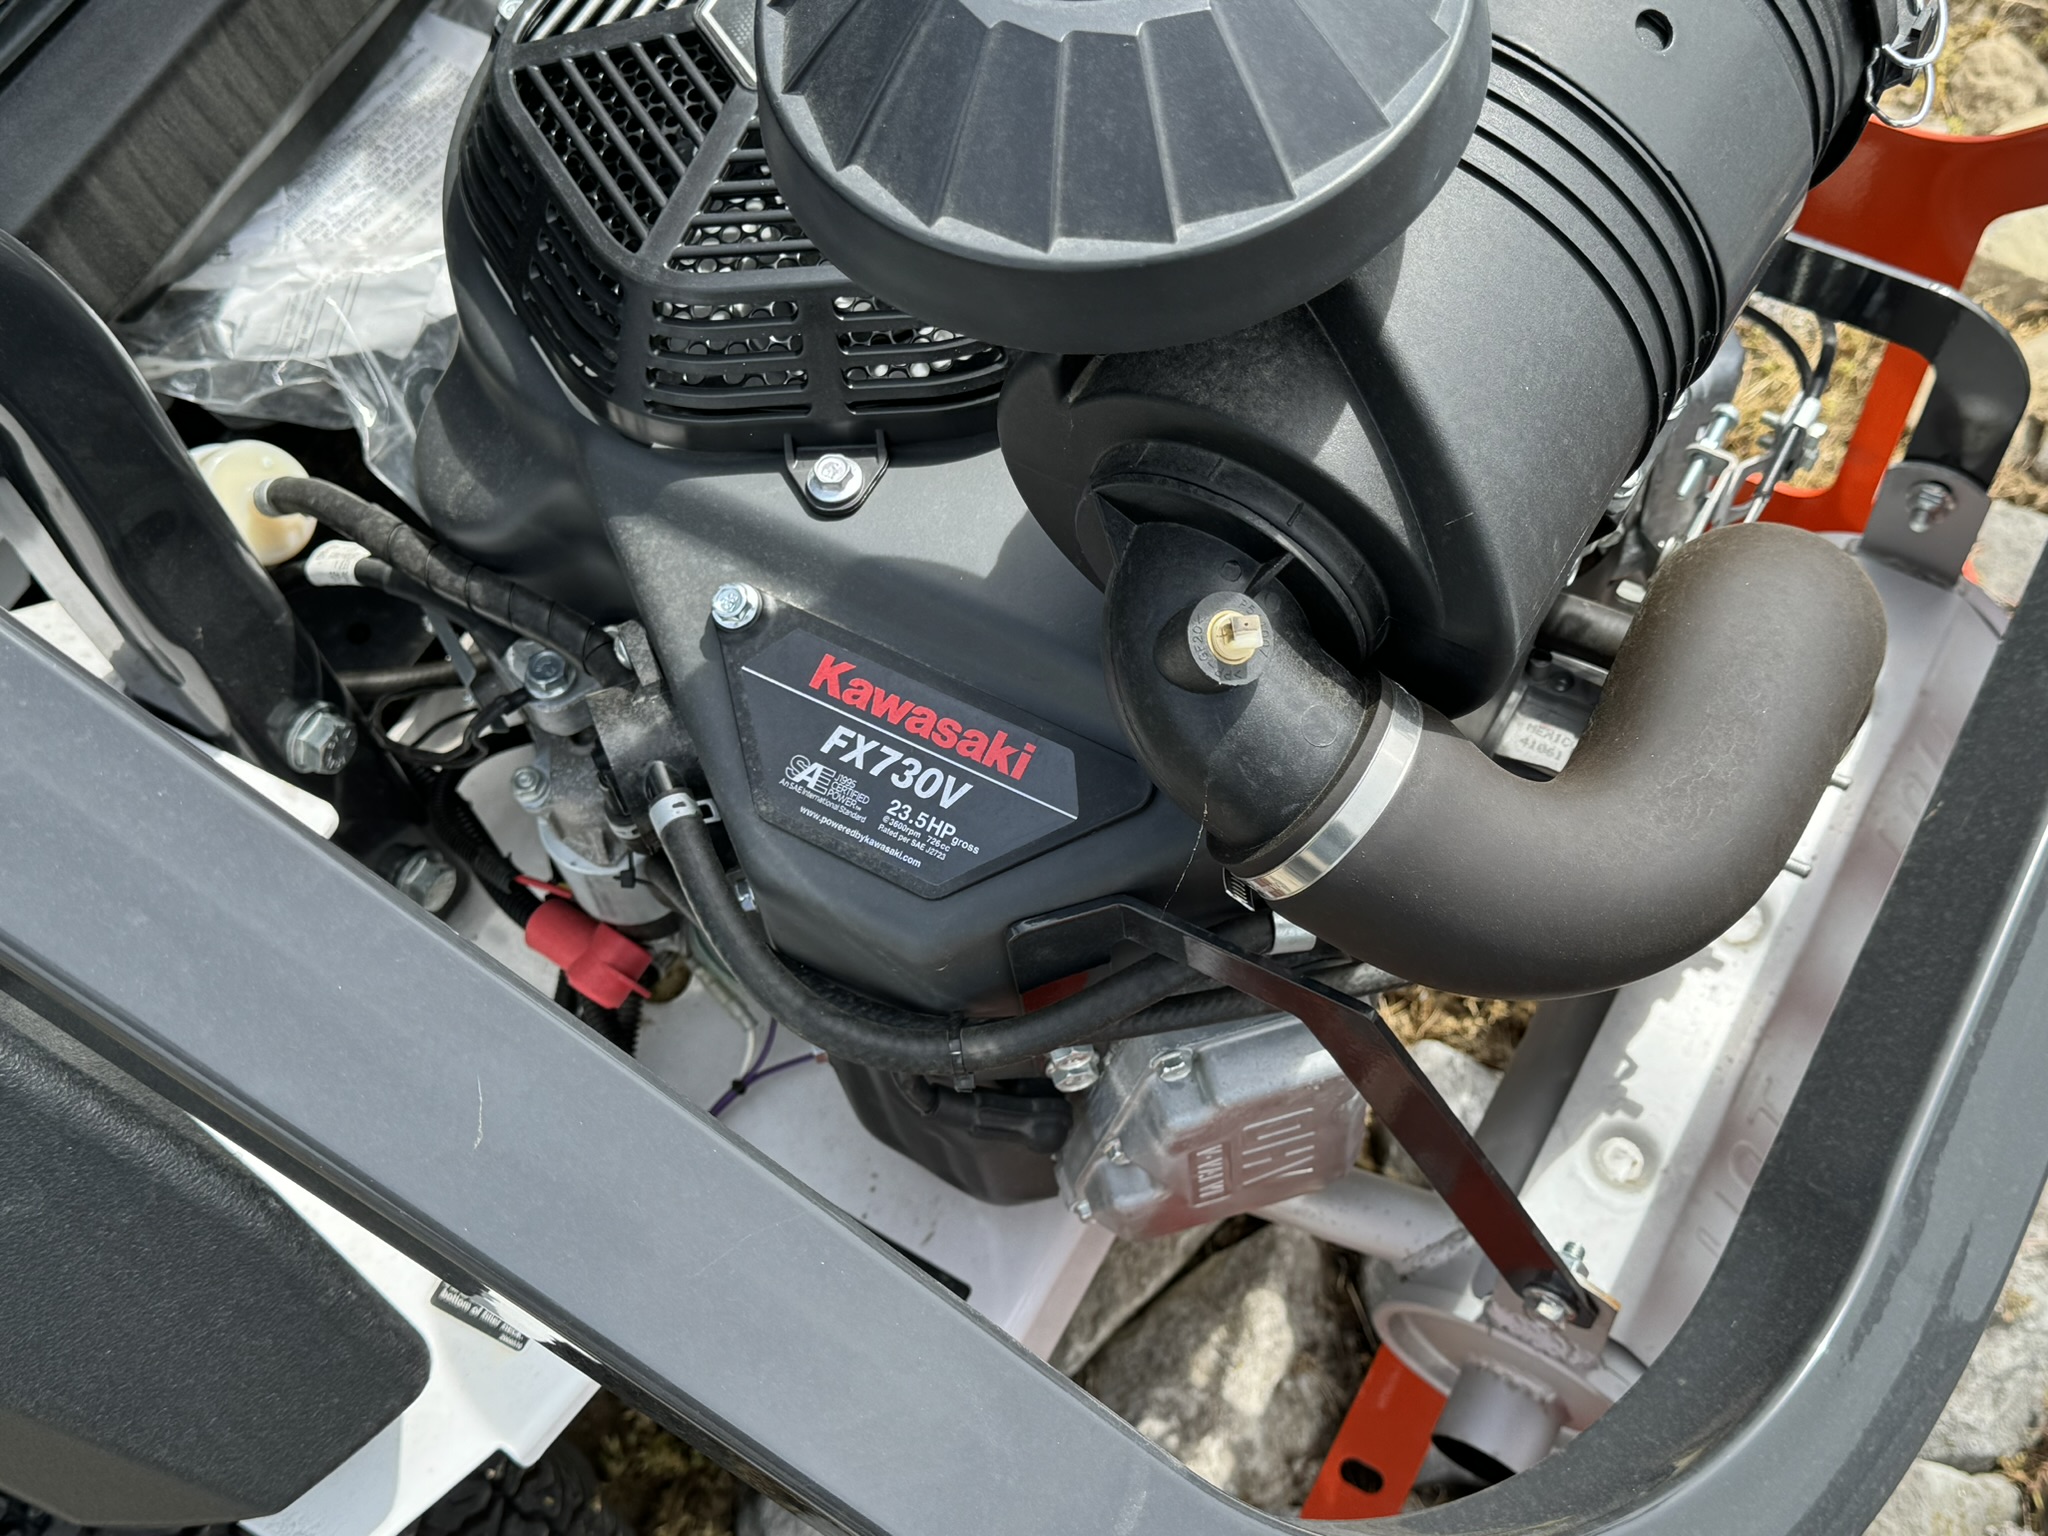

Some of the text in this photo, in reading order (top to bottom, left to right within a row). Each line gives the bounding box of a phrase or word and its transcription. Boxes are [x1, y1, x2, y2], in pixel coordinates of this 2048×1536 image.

[808, 653, 1037, 781] Kawasaki
[819, 725, 974, 810] FX730V
[778, 777, 868, 824] An SAE International Standard
[830, 781, 871, 805] CERTIFIED
[799, 805, 922, 868] www.poweredbykawasaki.com
[877, 823, 947, 861] Rated per SAE J2723
[950, 836, 980, 855] gross
